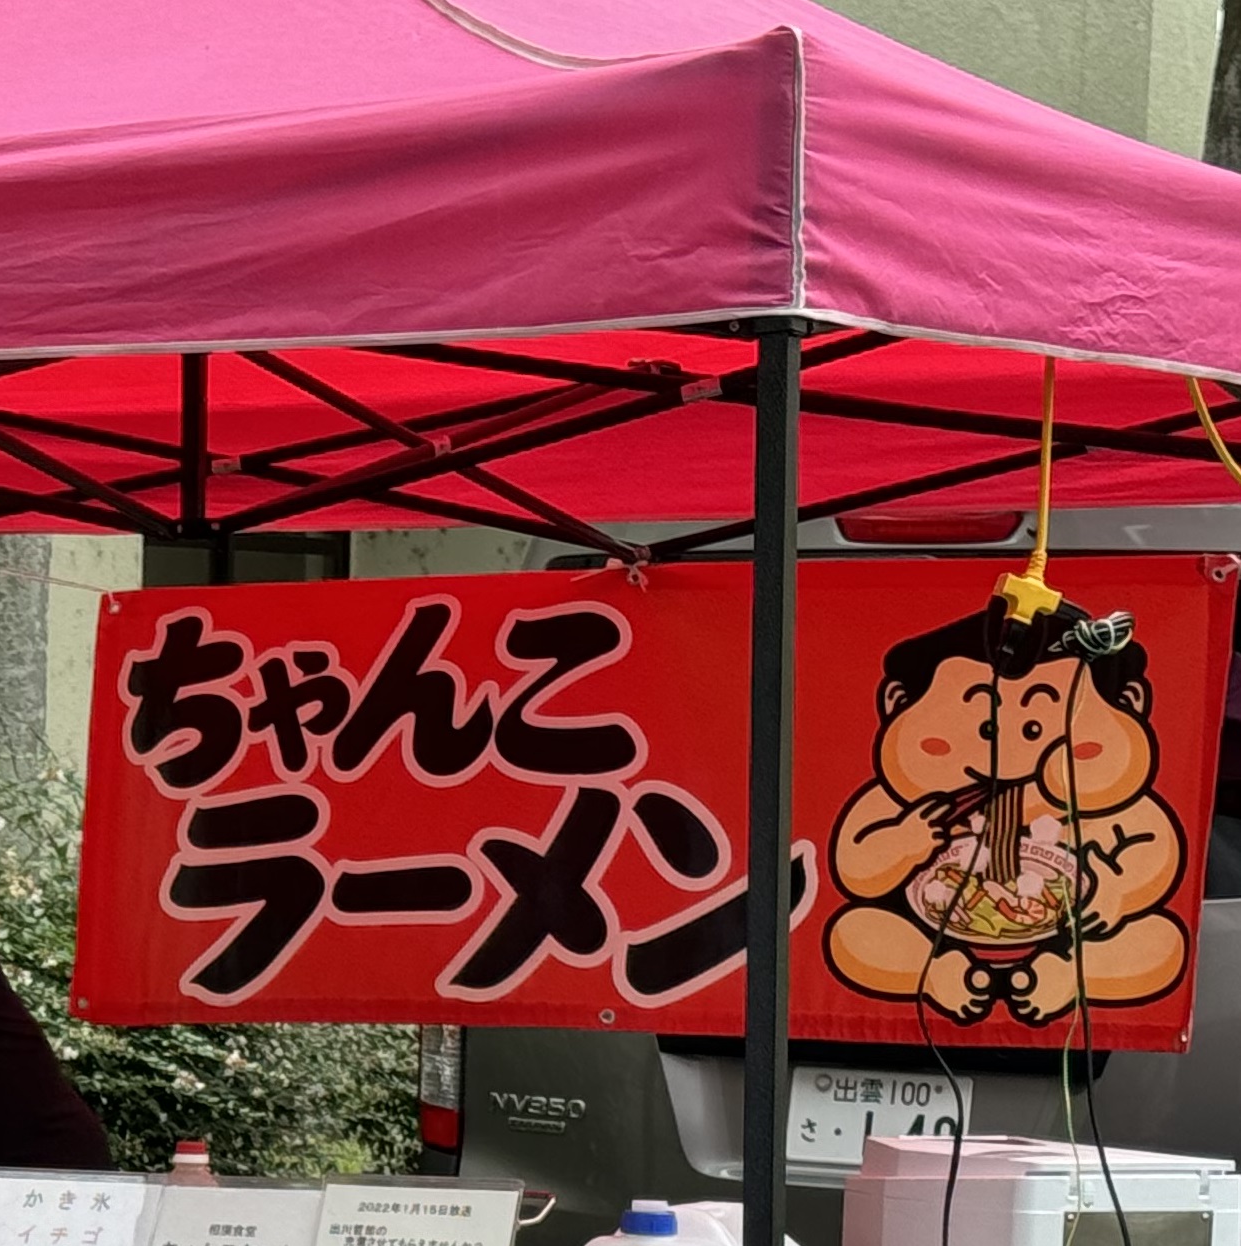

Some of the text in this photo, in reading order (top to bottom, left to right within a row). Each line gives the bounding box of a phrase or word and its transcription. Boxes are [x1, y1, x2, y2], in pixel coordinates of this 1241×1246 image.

[121, 597, 644, 790] ちゃんこ
[163, 785, 816, 1004] ラーメン
